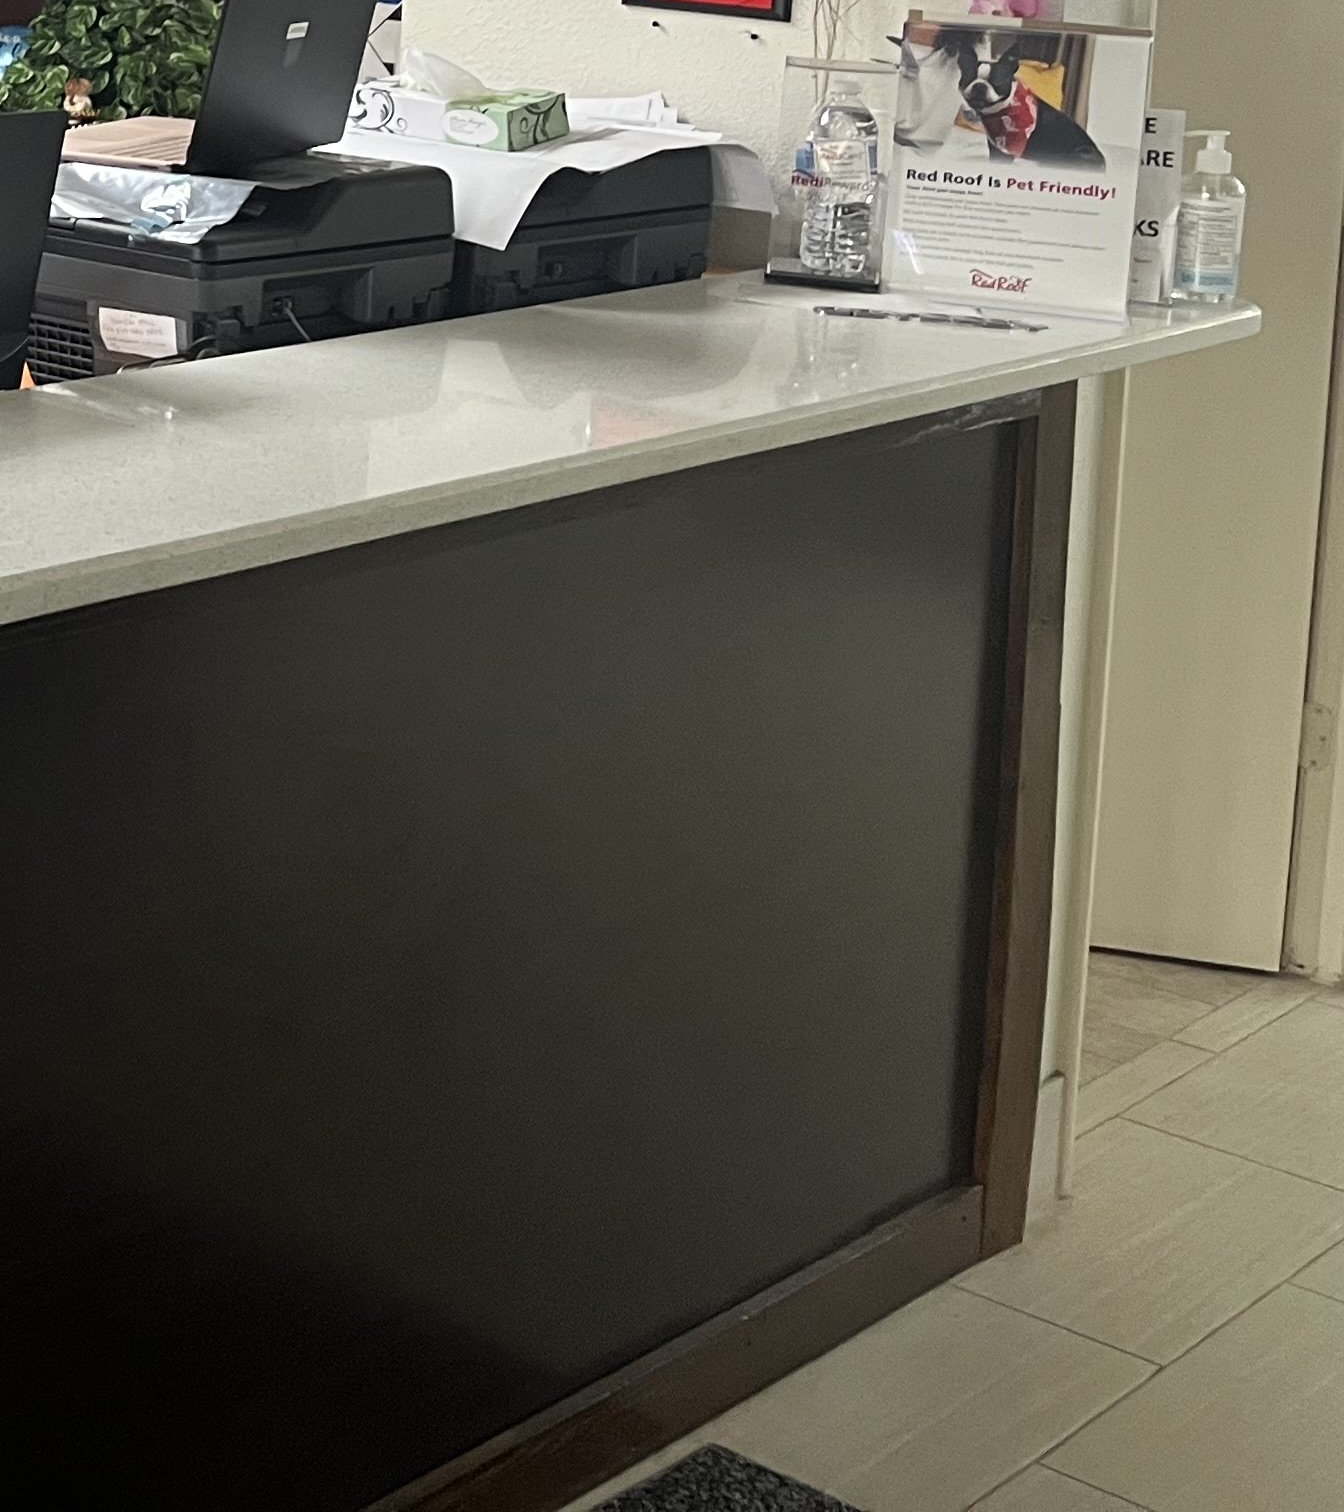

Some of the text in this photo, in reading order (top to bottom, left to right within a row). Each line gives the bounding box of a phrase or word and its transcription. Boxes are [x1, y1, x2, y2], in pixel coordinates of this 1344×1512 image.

[1140, 149, 1175, 168] RE
[906, 169, 1117, 201] Red Roof Is Pet Friendly!
